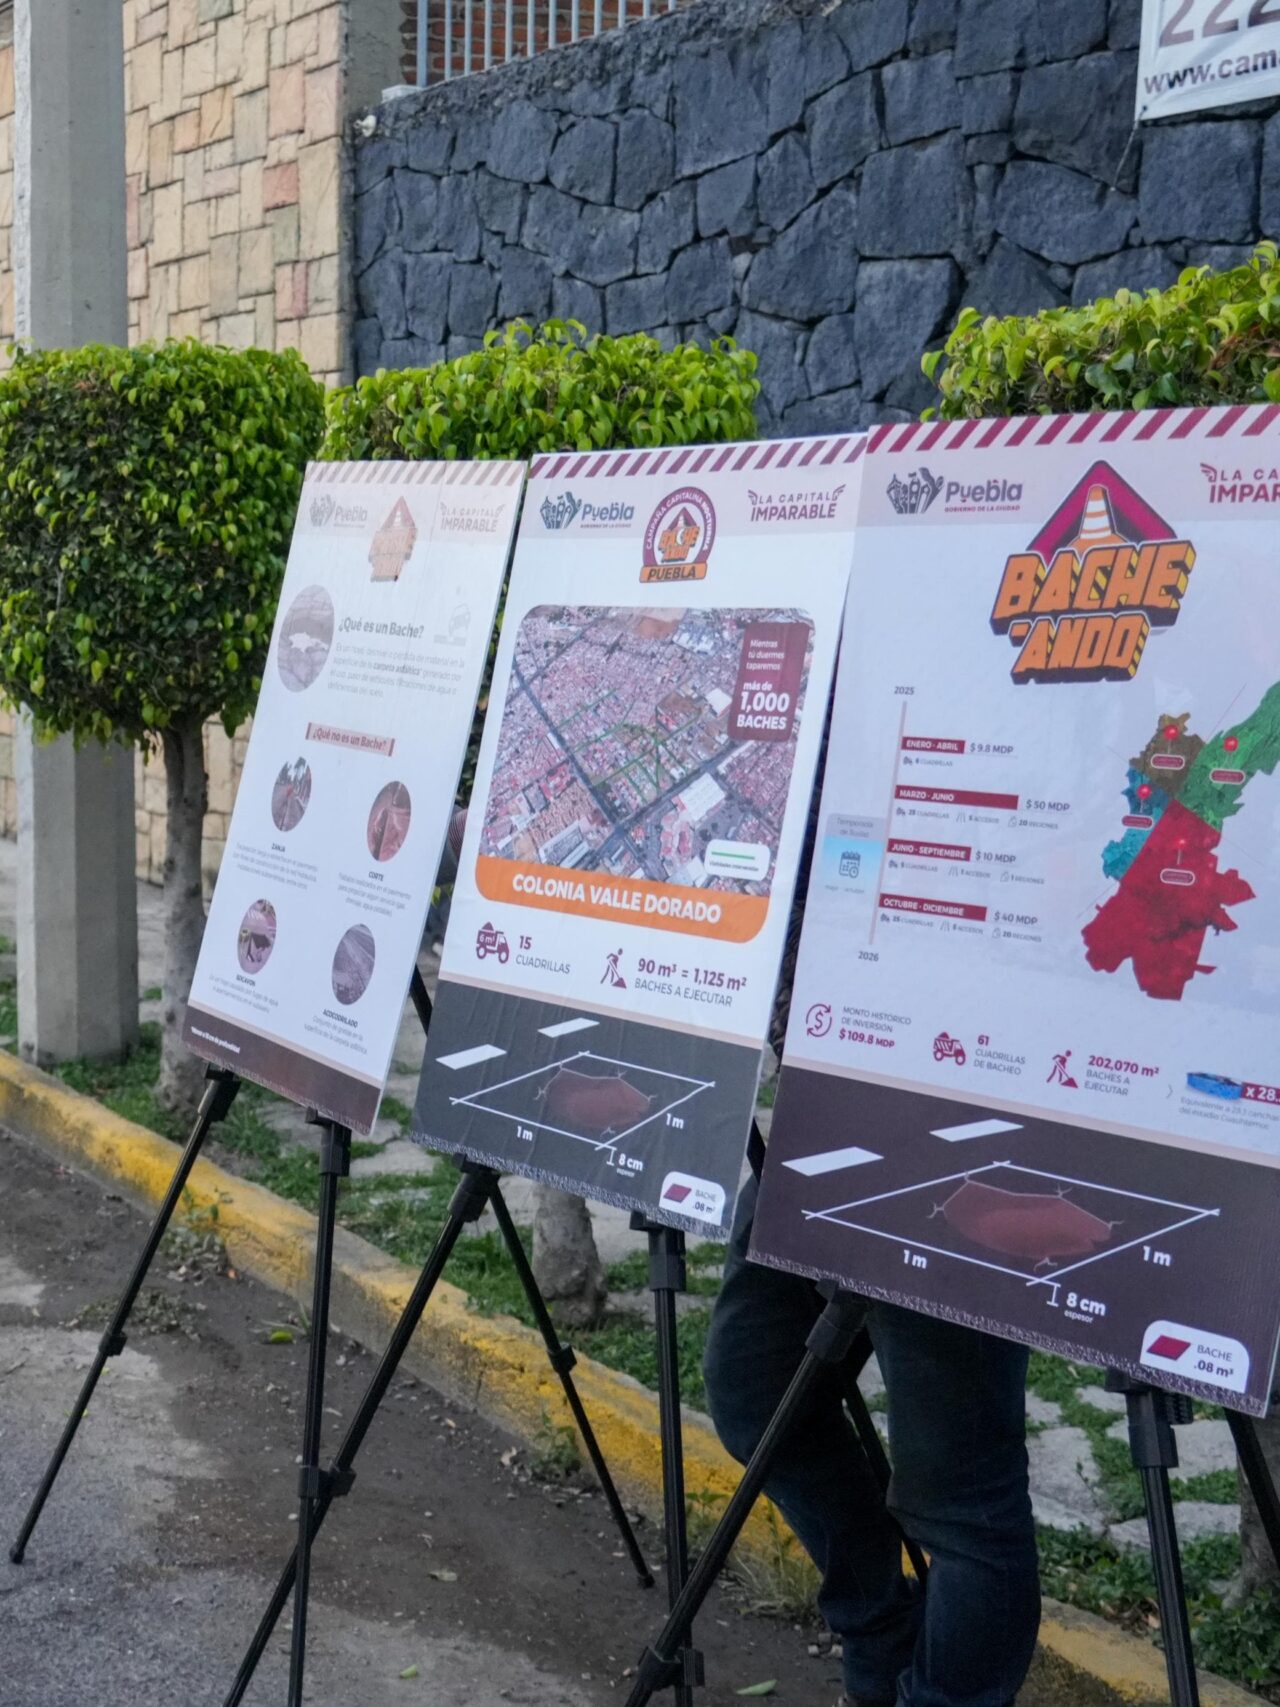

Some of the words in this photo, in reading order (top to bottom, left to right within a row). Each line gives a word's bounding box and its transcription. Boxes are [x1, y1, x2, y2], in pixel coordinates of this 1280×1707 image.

[1144, 49, 1280, 94] www.cam
[1221, 469, 1242, 481] LA
[759, 495, 772, 504] LA
[779, 491, 830, 504] CAPITAL
[945, 479, 1023, 503] Puebla
[334, 506, 368, 523] Puebla
[581, 502, 634, 521] Puebla
[750, 503, 837, 522] IMPARABLE
[440, 518, 498, 533] IMPARABLE
[647, 565, 696, 580] PUEBLA
[991, 540, 1196, 634] BACHE
[338, 617, 362, 633] ¿Qué
[363, 621, 374, 632] es
[375, 622, 388, 634] un
[389, 621, 424, 639] Bache?
[750, 639, 778, 648] Mientras
[756, 650, 785, 659] duermes
[746, 662, 781, 671] taparemos
[743, 680, 761, 691] más
[762, 681, 773, 691] de
[894, 686, 914, 695] 2025
[740, 691, 790, 713] 1,000
[736, 714, 787, 730] BACHES
[331, 731, 340, 741] no
[350, 735, 360, 746] un
[906, 740, 932, 749] ENERO
[936, 742, 959, 751] ABRIL
[977, 743, 991, 753] 9.8
[992, 745, 1014, 754] MDP
[899, 789, 926, 799] MARZO
[931, 791, 955, 802] JUNIO
[1033, 800, 1046, 810] 50
[1048, 801, 1070, 812] MDP
[892, 843, 914, 853] JUNIO
[919, 846, 966, 859] SEPTIEMBRE
[983, 851, 993, 862] 10
[994, 853, 1017, 863] MDP
[512, 873, 586, 902] COLONIA
[589, 884, 642, 912] VALLE
[644, 893, 722, 924] DORADO
[883, 898, 918, 910] OCTUBRE
[923, 901, 964, 916] DICIEMBRE
[1002, 912, 1014, 923] 40
[1015, 914, 1038, 925] MDP
[519, 935, 532, 950] 15
[516, 954, 571, 975] CUADRILLAS
[858, 951, 879, 962] 2026
[638, 958, 656, 974] 90
[693, 968, 725, 988] 1,125
[634, 977, 673, 996] BACHES
[674, 986, 681, 998] A
[683, 987, 733, 1007] EJECUTAR
[843, 1005, 870, 1018] MONTO
[841, 1017, 852, 1025] DE
[847, 1029, 874, 1044] 109.8
[875, 1037, 895, 1049] MDP
[977, 1034, 990, 1047] 61
[975, 1048, 1026, 1065] CUADRILLAS
[1088, 1054, 1139, 1075] 202,070
[973, 1059, 985, 1068] DE
[986, 1061, 1022, 1075] BACHEO
[1086, 1069, 1122, 1084] BACHES
[1123, 1077, 1130, 1085] A
[1084, 1081, 1129, 1097] EJECUTAR
[1257, 1086, 1280, 1102] 28.
[1064, 1309, 1093, 1324] espesor
[1197, 1344, 1233, 1362] BACHE
[1193, 1359, 1214, 1373] .08
